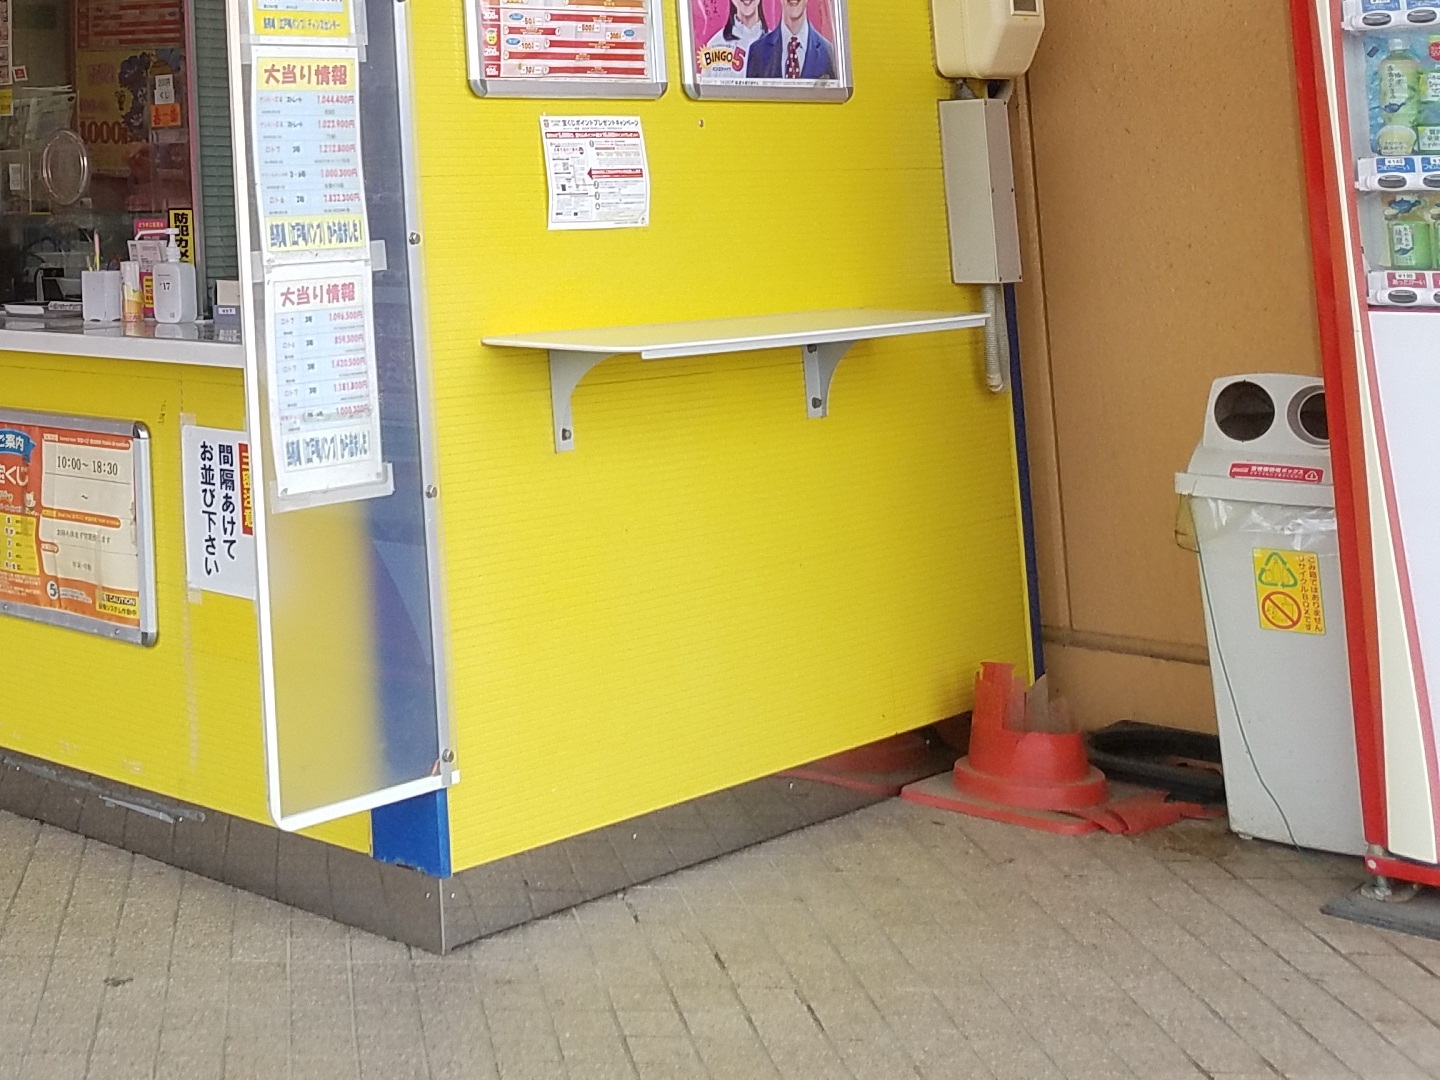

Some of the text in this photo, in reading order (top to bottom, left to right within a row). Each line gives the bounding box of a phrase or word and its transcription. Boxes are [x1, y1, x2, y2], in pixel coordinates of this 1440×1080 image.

[264, 64, 347, 85] 大当り情報
[174, 213, 189, 263] 防犯カメ
[281, 282, 355, 307] 大当り情報
[92, 461, 118, 475] 18:30
[200, 441, 219, 575] お並び下さい
[218, 444, 236, 560] 間隔あけて
